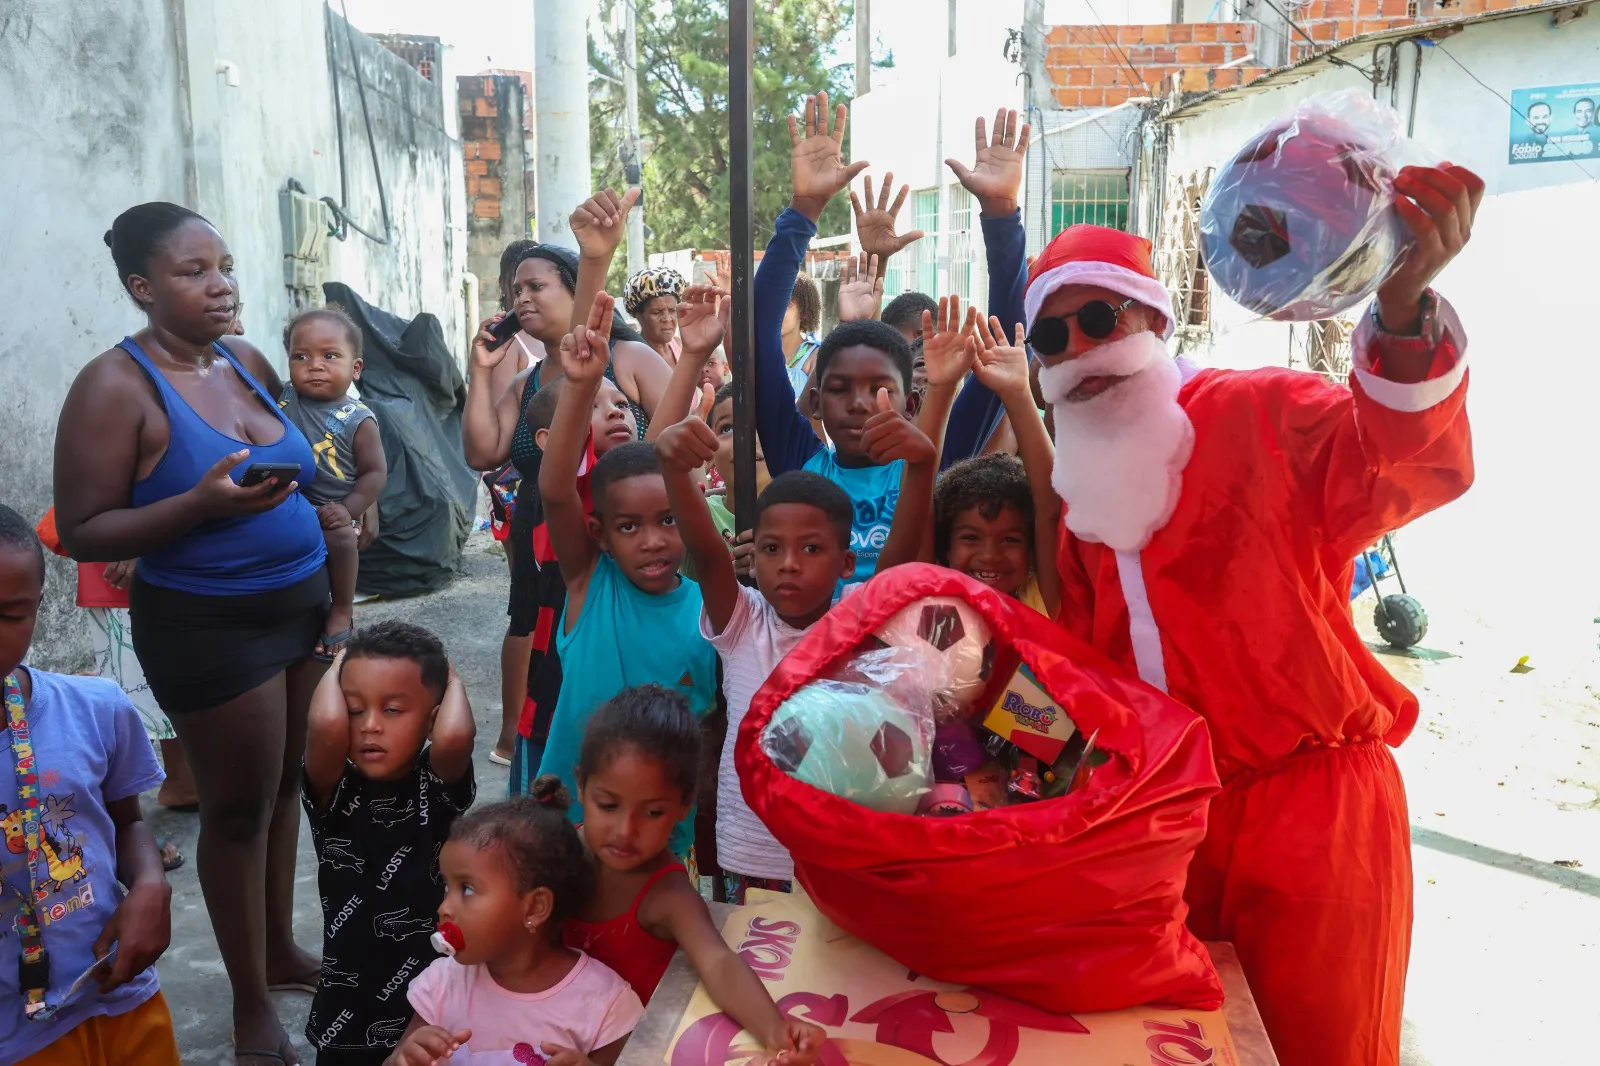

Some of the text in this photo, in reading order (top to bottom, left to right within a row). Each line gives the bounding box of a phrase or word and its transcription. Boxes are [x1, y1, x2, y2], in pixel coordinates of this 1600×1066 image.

[850, 524, 891, 549] ove
[856, 550, 880, 558] Esport
[375, 845, 413, 891] LACOSTE
[326, 894, 363, 939] LACOSTE
[376, 956, 420, 1002] LACOSTE
[317, 1008, 354, 1051] ACOSTE
